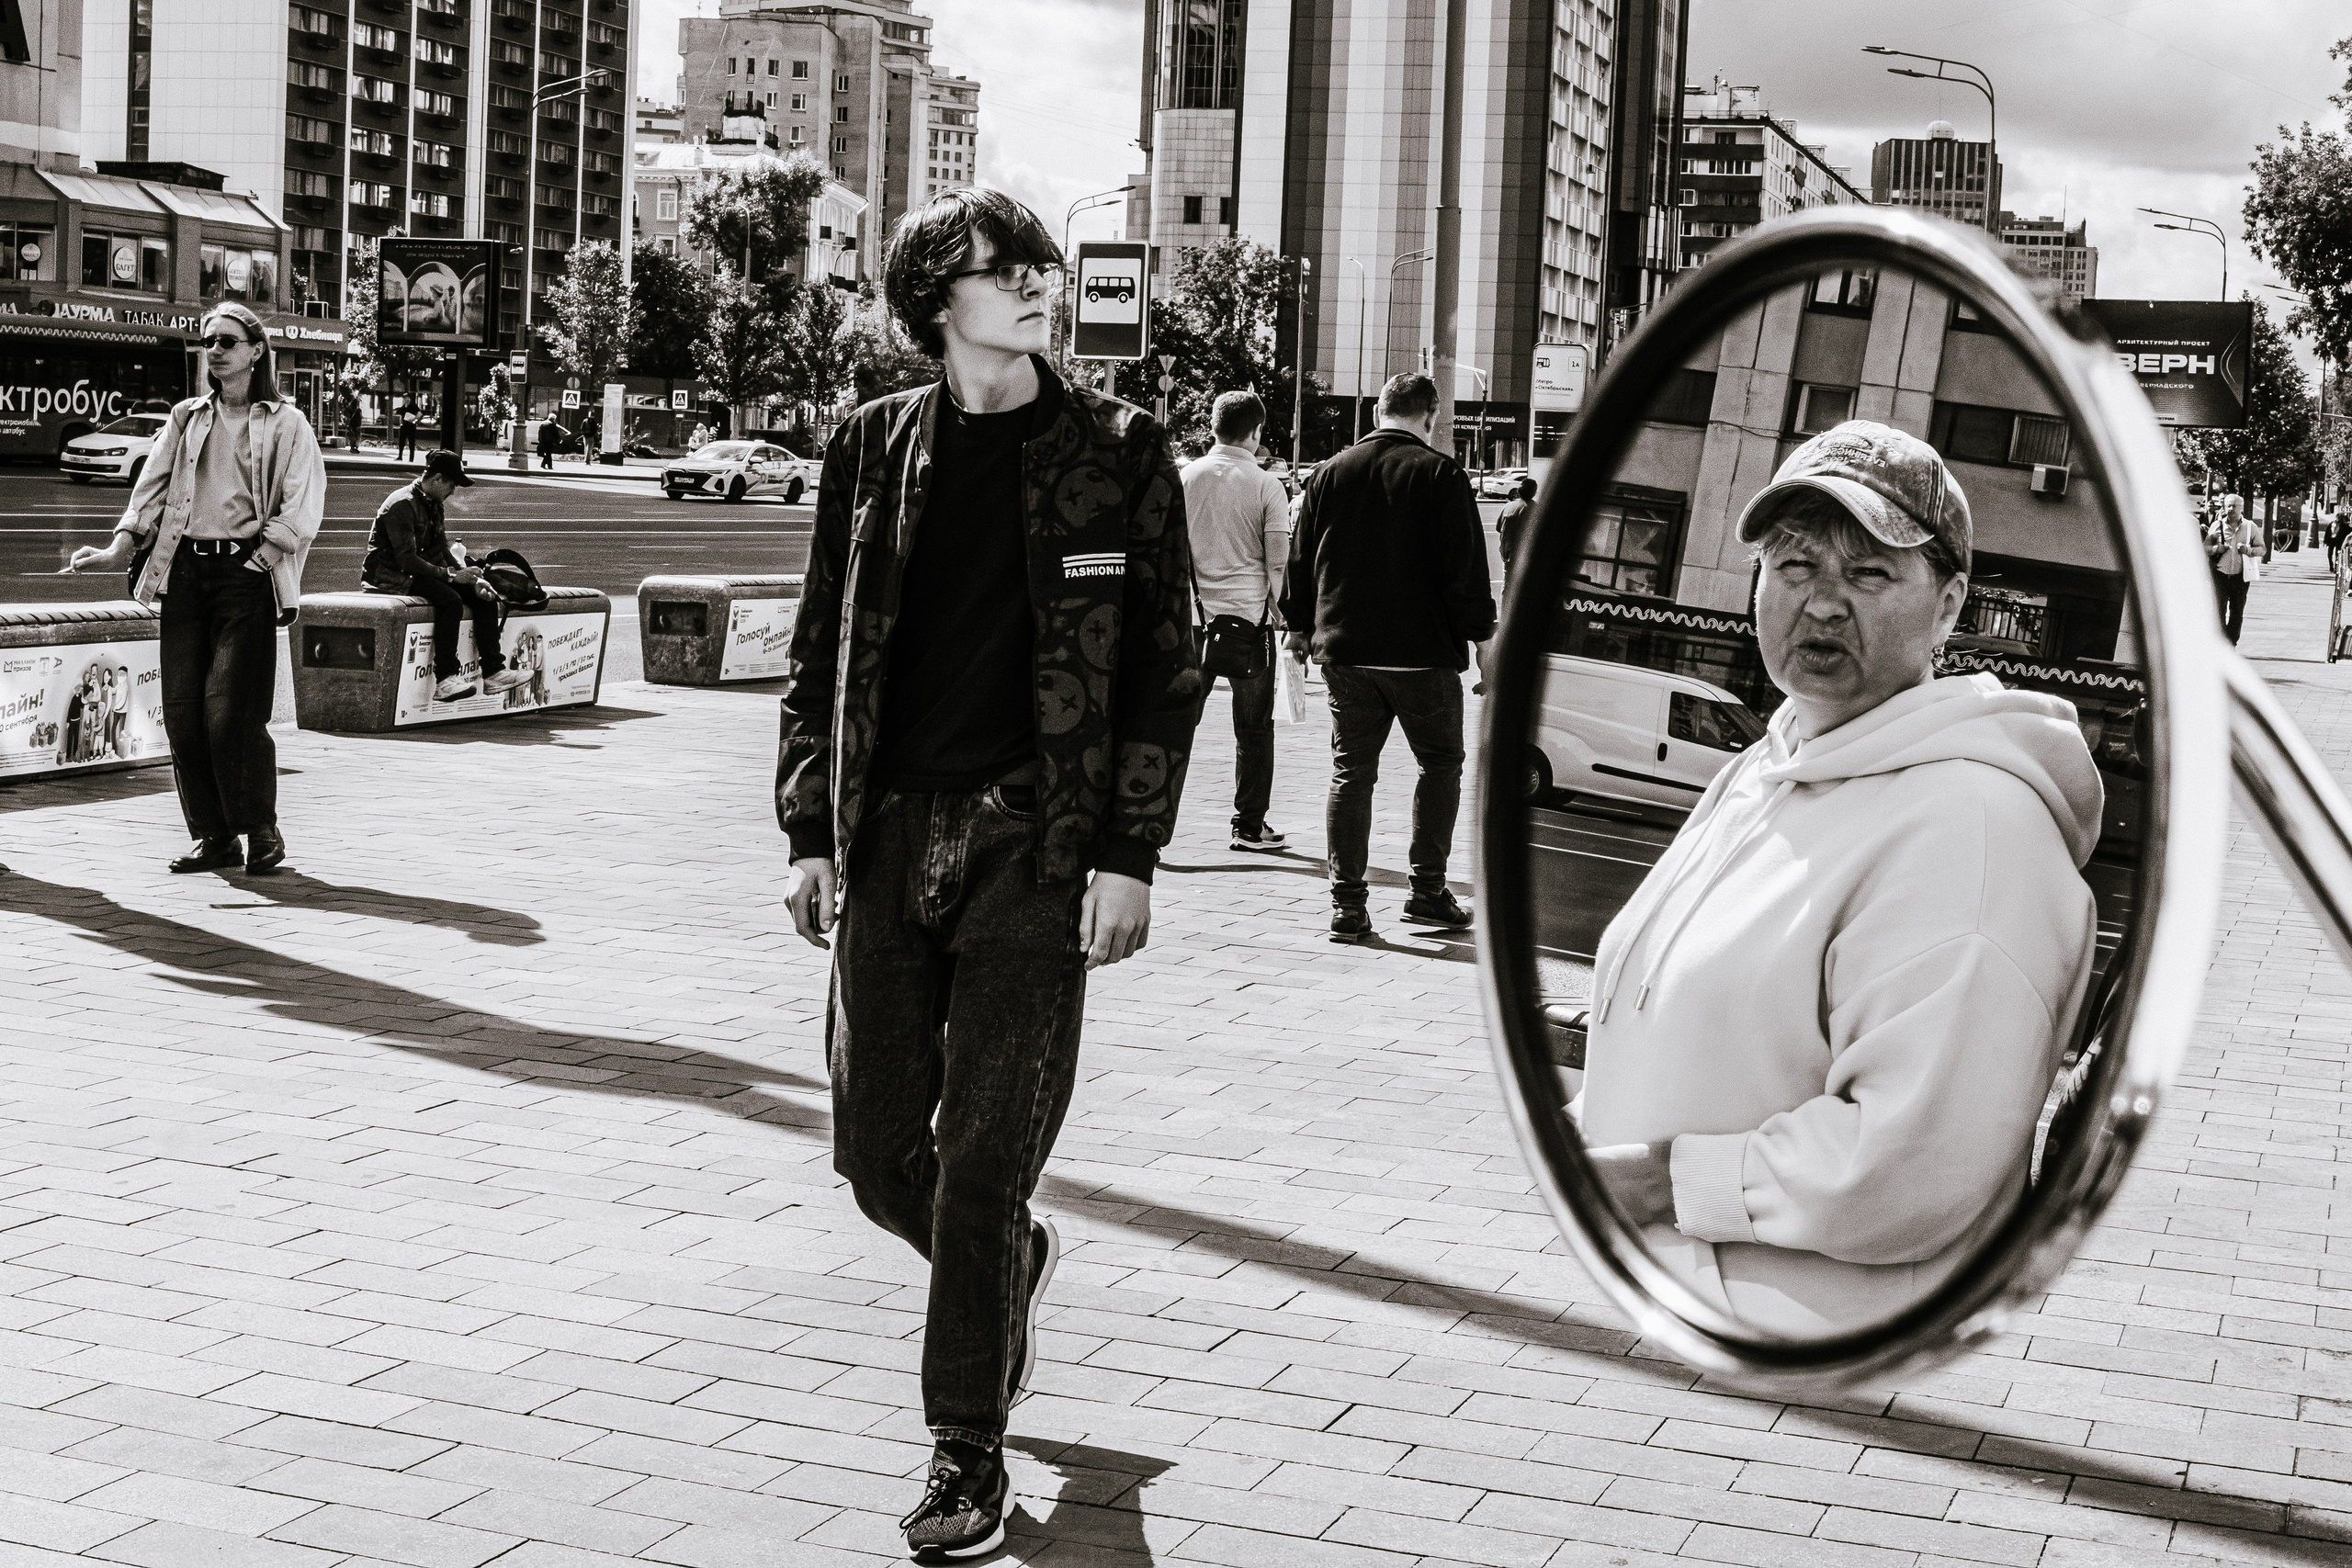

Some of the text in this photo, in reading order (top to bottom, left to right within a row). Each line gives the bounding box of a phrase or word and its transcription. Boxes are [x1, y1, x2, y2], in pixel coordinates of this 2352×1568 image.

[124, 310, 164, 327] ТАБАК
[1065, 566, 1114, 579] FASHION
[5, 714, 38, 731] сентября
